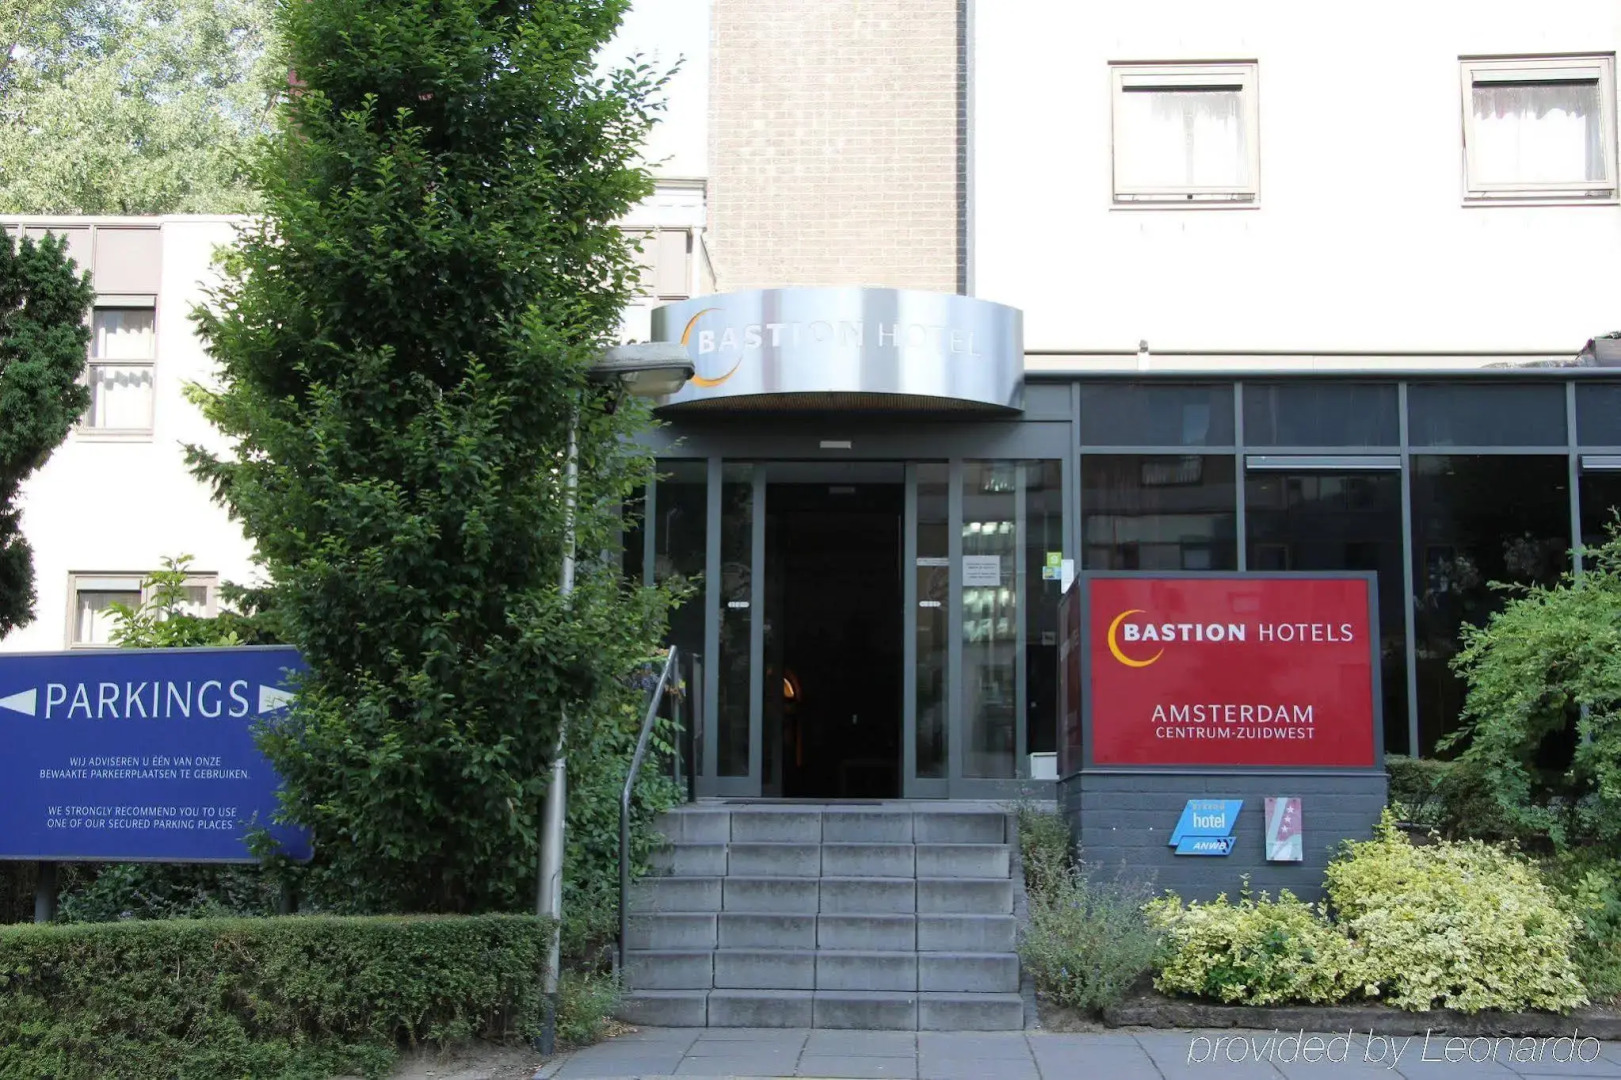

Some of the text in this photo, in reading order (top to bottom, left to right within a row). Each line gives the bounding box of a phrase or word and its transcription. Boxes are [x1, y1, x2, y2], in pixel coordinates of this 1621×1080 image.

[698, 320, 982, 358] BASTION HOTEL
[1123, 623, 1354, 642] BASTION HOTELS
[45, 679, 250, 719] PARKINGS
[1151, 704, 1314, 724] AMSTERDAM
[1155, 726, 1315, 740] CENTRUM-ZUIDWEST
[69, 757, 86, 767] WIJ
[88, 756, 140, 767] ADVISEREN
[142, 757, 150, 766] U
[173, 756, 193, 766] VAN
[195, 756, 222, 766] ONZE
[39, 769, 88, 779] BEWAAKTE
[90, 769, 177, 779] PARKEERPLAATSEN
[181, 769, 191, 779] TE
[48, 806, 237, 817] WE STRONGLY RECOMMEND YOU TO USE
[47, 818, 67, 828] ONE
[70, 818, 82, 828] OF
[85, 818, 106, 828] OUR
[108, 819, 151, 829] SECURED
[153, 819, 195, 829] PARKING
[1193, 812, 1225, 828] hotel
[1193, 841, 1227, 850] ANWB
